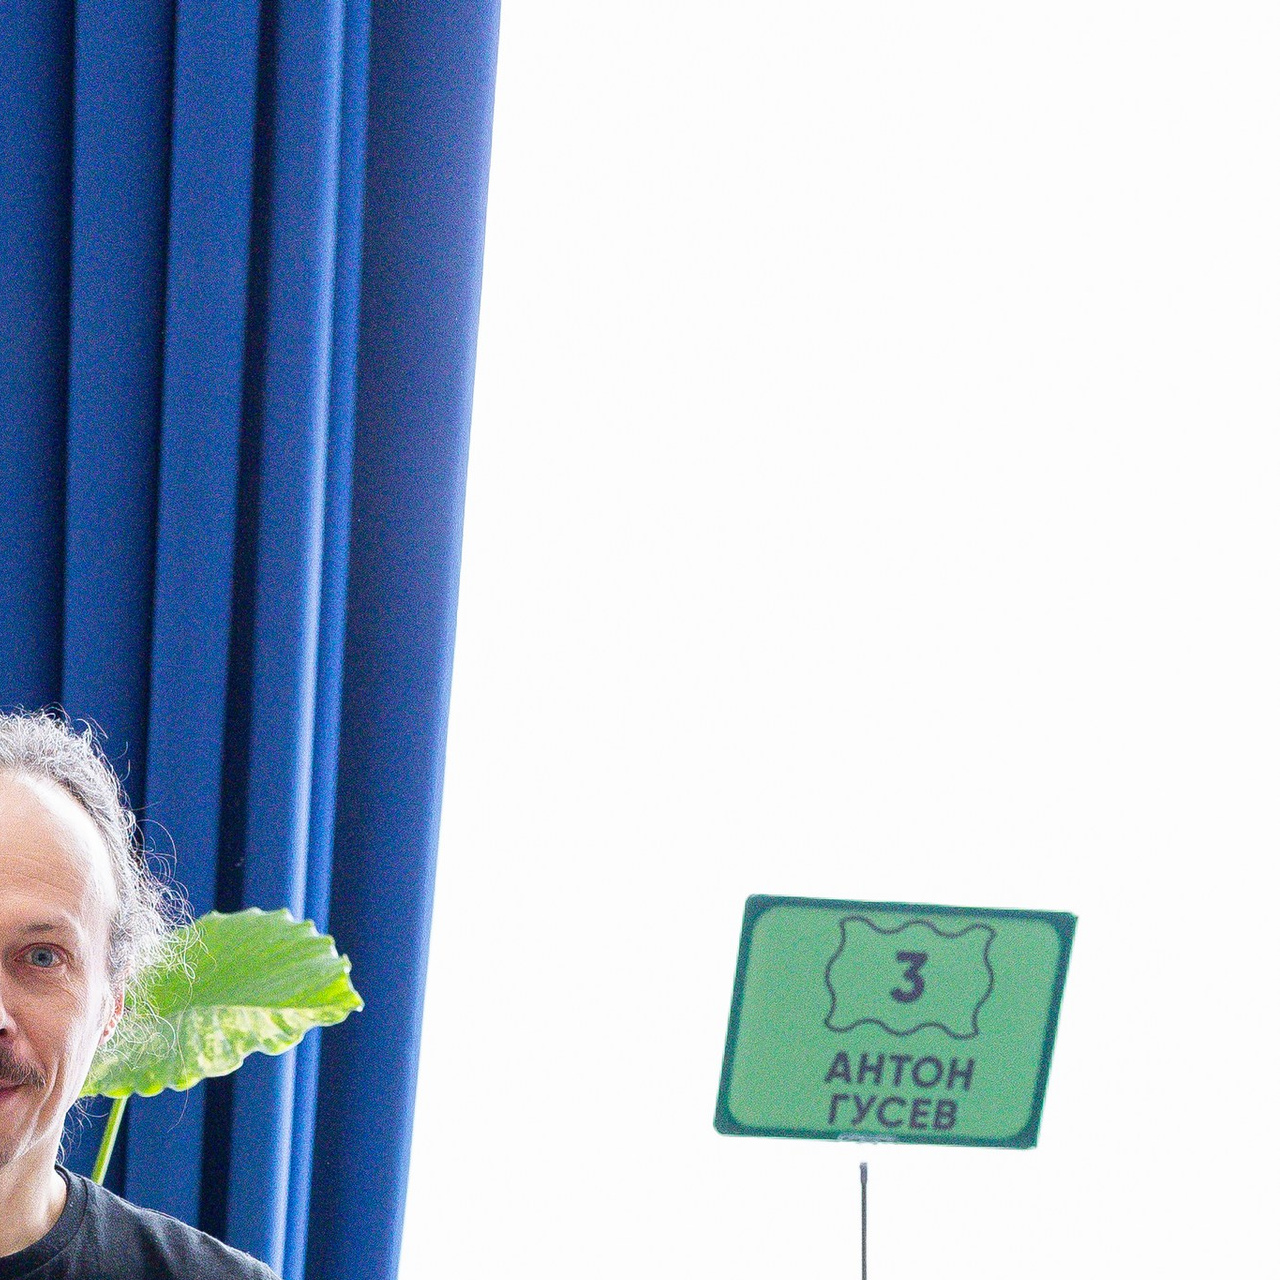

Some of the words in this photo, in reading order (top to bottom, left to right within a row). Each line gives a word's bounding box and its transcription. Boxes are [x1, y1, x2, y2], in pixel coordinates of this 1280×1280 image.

[890, 951, 927, 1003] 3
[824, 1051, 974, 1090] АНТОН
[827, 1094, 958, 1131] ГУСЕВ
